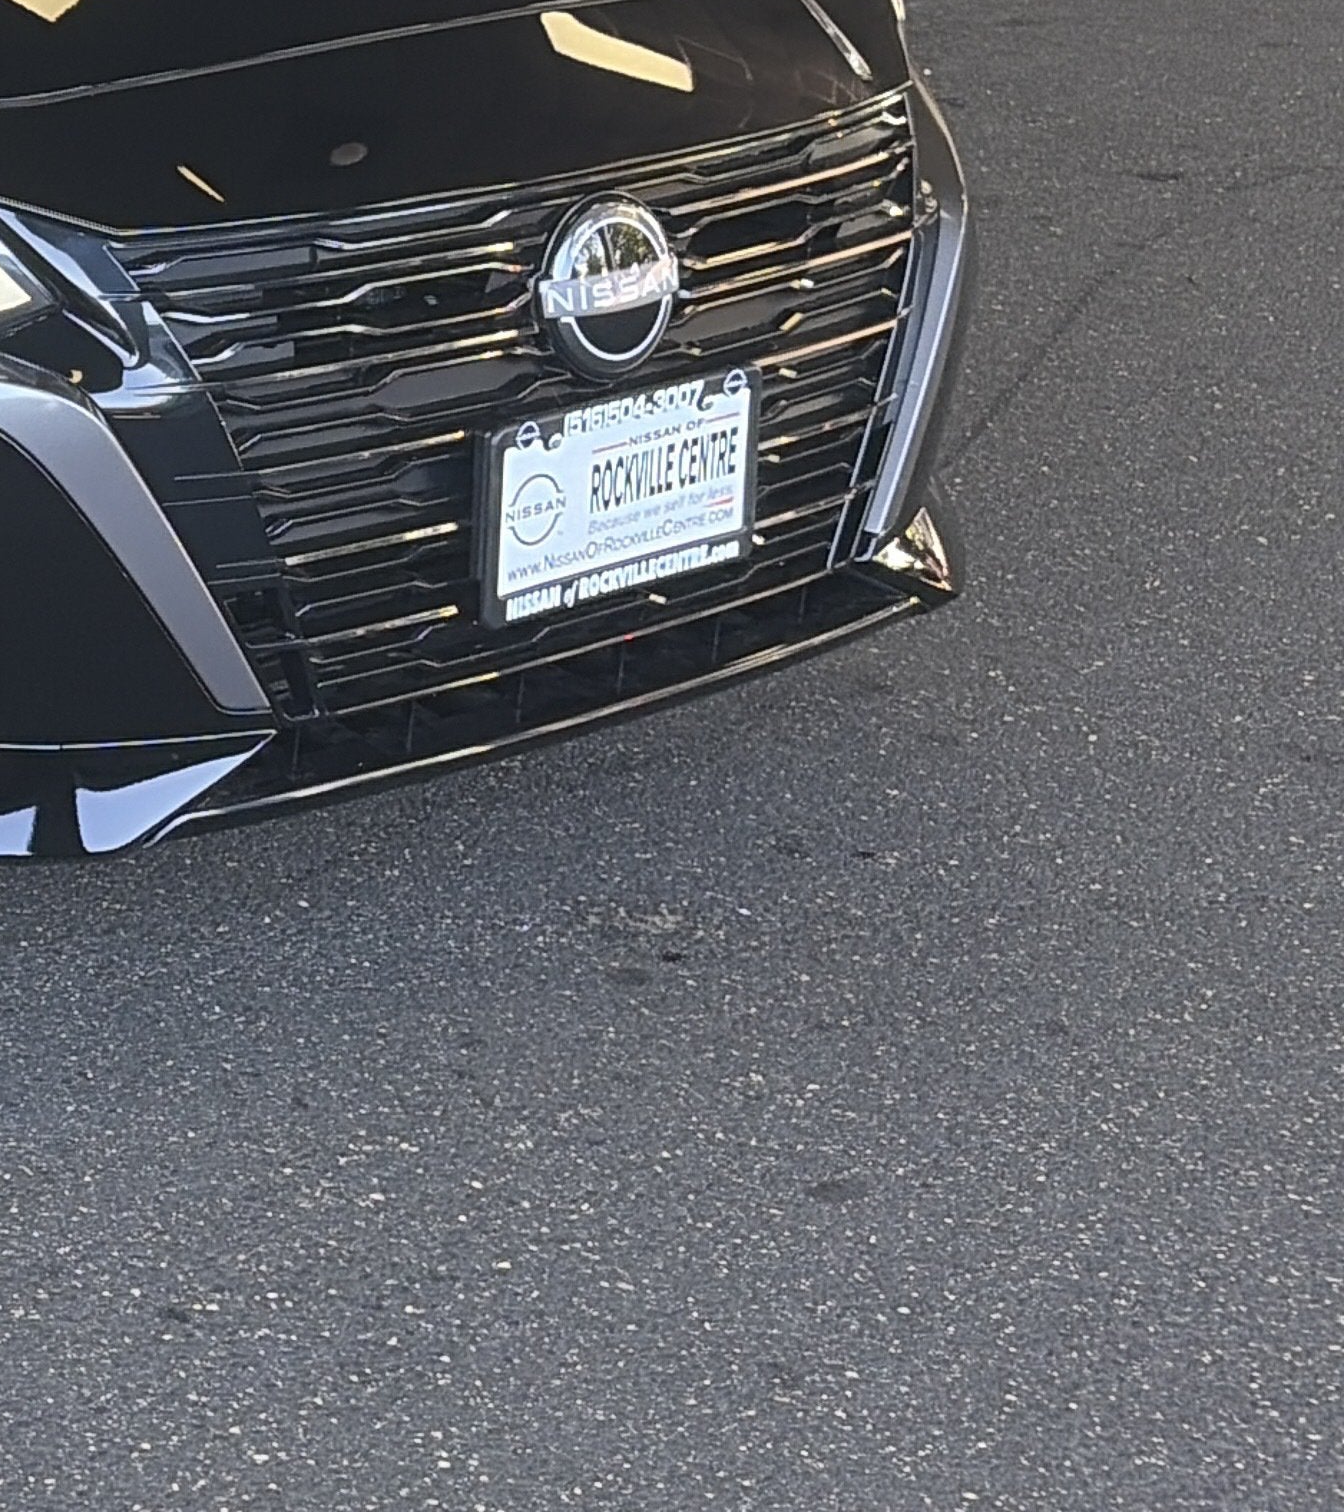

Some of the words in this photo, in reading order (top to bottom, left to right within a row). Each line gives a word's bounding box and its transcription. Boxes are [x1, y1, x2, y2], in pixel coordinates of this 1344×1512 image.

[546, 260, 678, 314] NISSAN
[629, 424, 681, 445] NISSAN
[686, 417, 705, 431] OF
[590, 443, 675, 514] ROCKVILLE
[679, 426, 739, 488] CENTRE
[505, 496, 567, 523] NISSAN
[505, 584, 562, 622] NISSAN
